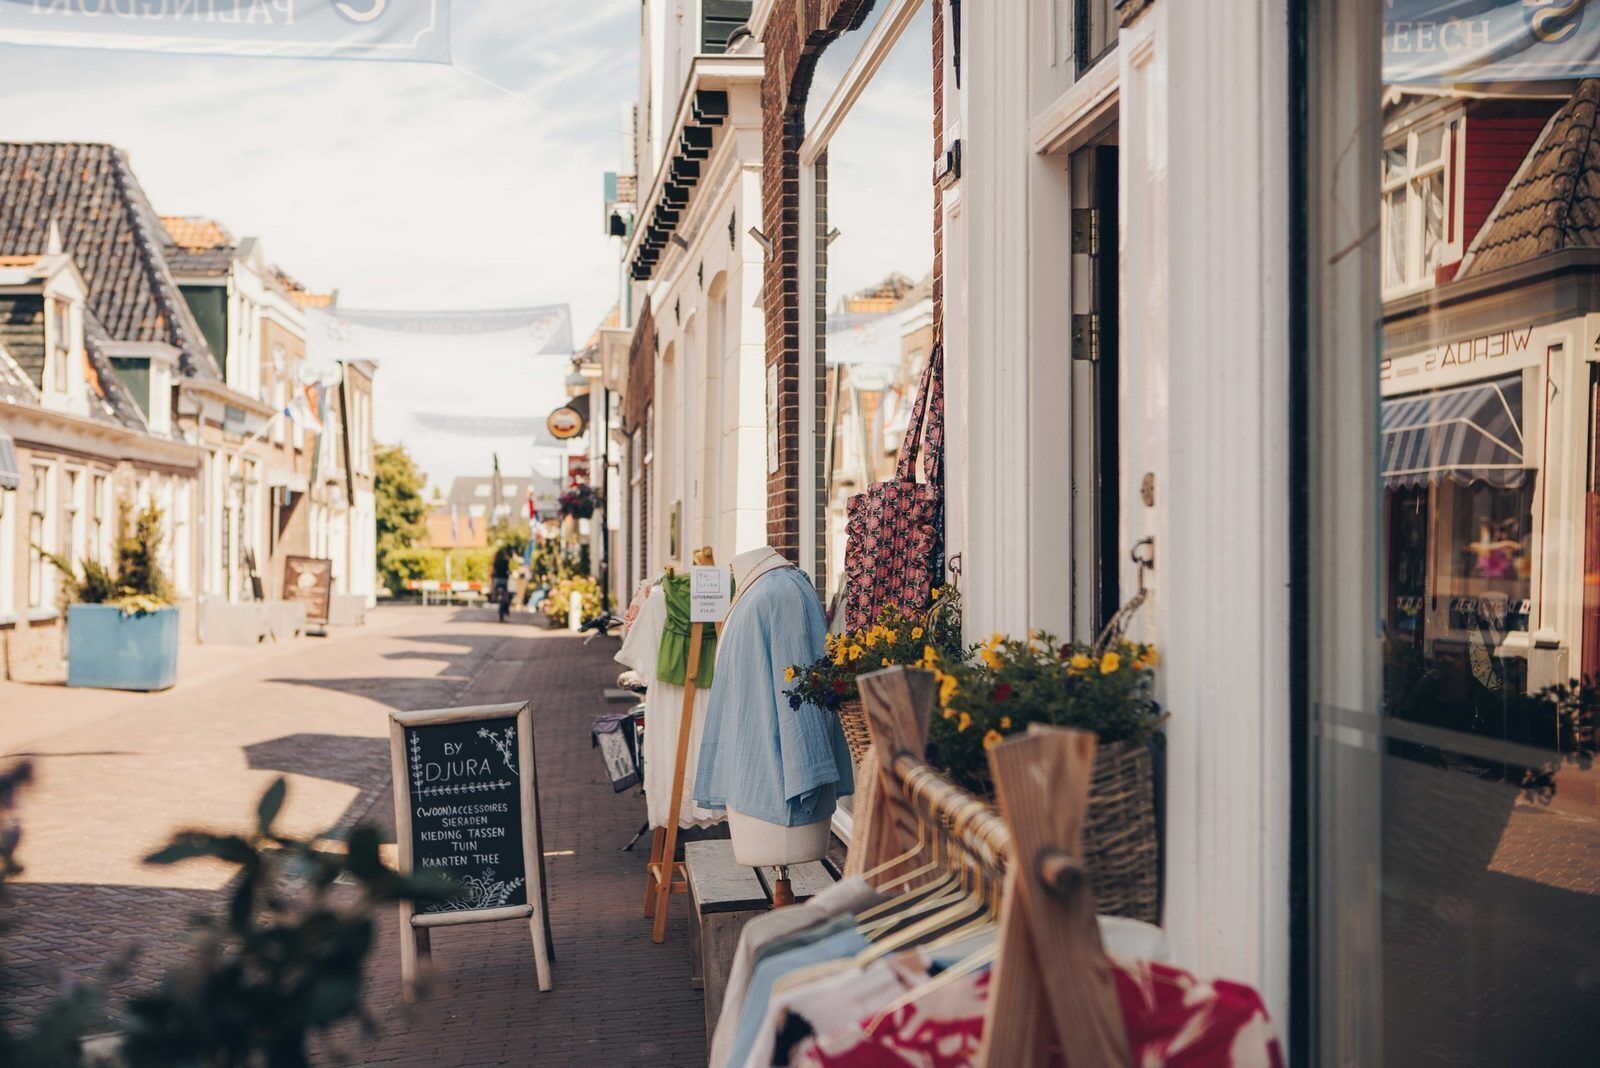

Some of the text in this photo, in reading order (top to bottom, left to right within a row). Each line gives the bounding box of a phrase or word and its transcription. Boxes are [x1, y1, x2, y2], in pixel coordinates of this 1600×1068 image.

[444, 742, 463, 755] BY
[425, 758, 492, 781] DJURA
[416, 803, 508, 818] (WOON)ACCESSOIRES
[442, 816, 488, 827] SIERADEN
[467, 827, 505, 838] TASSEN
[451, 841, 478, 851] TUIN
[422, 854, 500, 868] KAARTEN THEE
